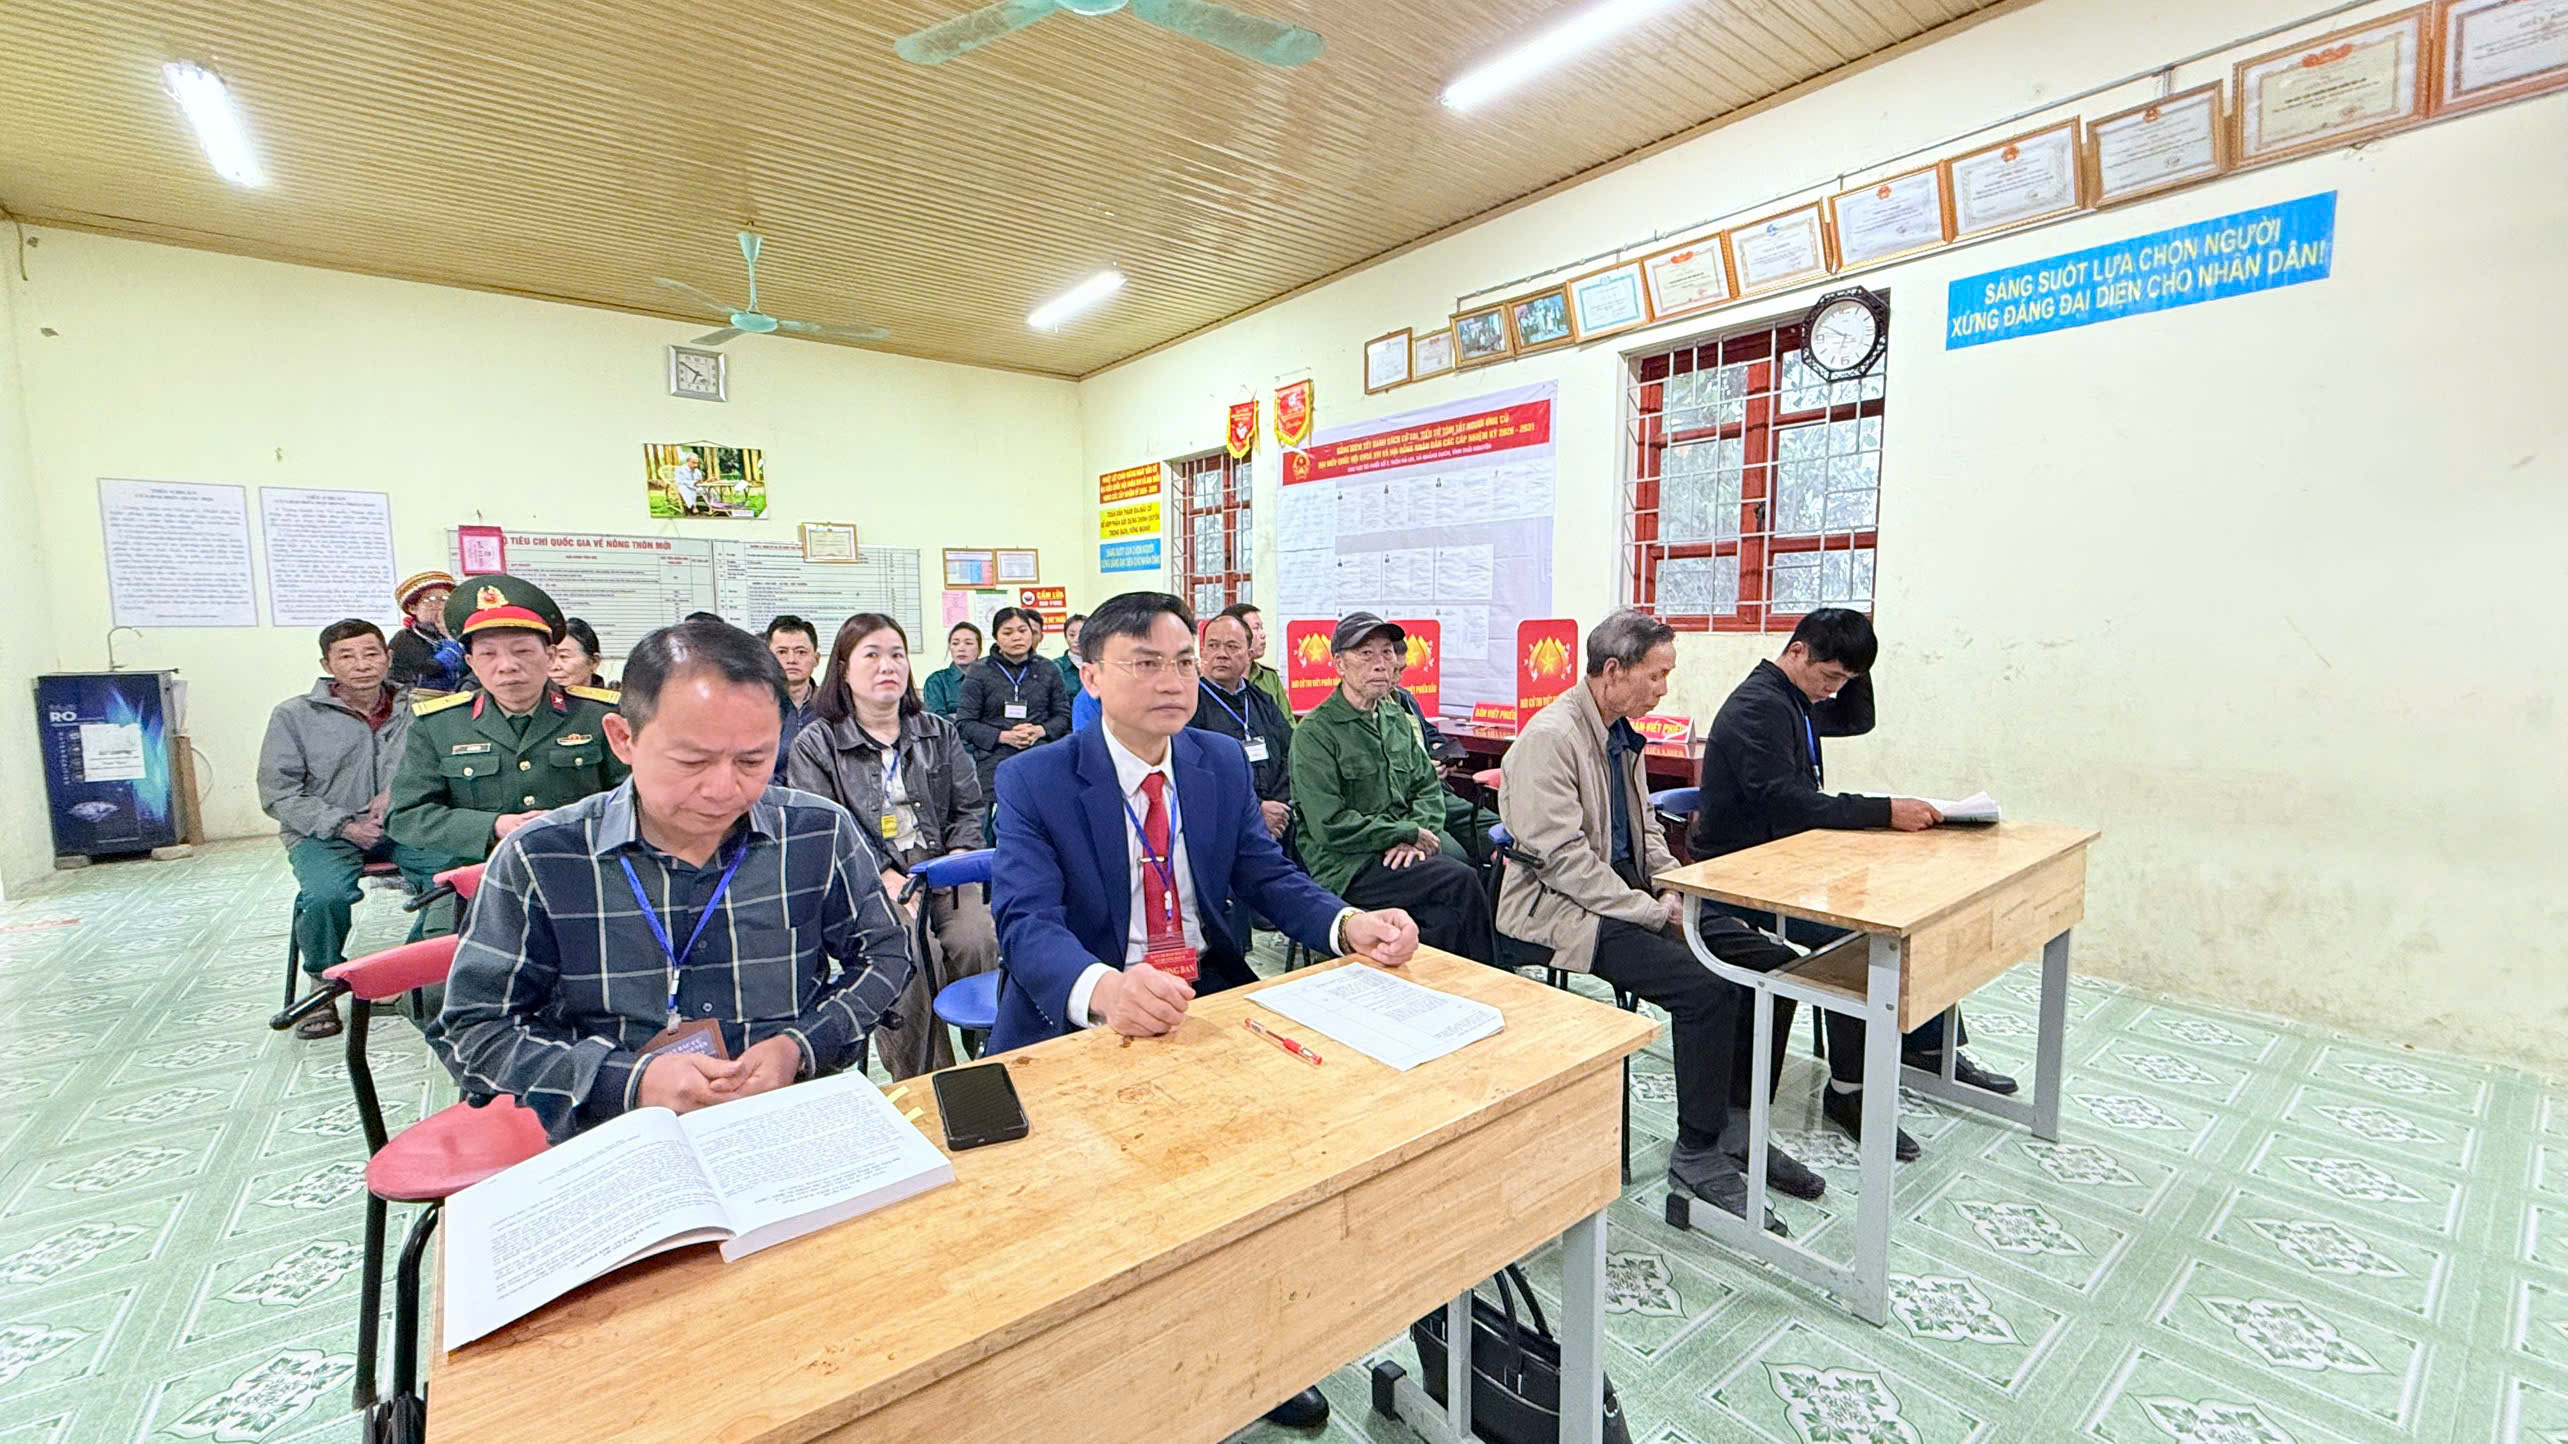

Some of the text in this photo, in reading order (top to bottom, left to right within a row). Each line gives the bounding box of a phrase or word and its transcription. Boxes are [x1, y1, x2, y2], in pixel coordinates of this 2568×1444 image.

[1985, 215, 2281, 305] SÁNG SUỐT LỰA CHỌN NGƯỜI
[1951, 239, 2325, 338] XỨNG ĐÁNG ĐẠI DIỆN CHO NHÂN DÂN!
[511, 535, 530, 546] TIÊU
[533, 535, 548, 546] CHÍ
[550, 536, 574, 548] QUỐC
[576, 538, 592, 548] GIA
[594, 537, 604, 548] VỀ
[606, 537, 630, 549] NÔNG
[633, 538, 653, 550] THÔN
[655, 539, 672, 551] MỚI
[49, 711, 77, 723] RO
